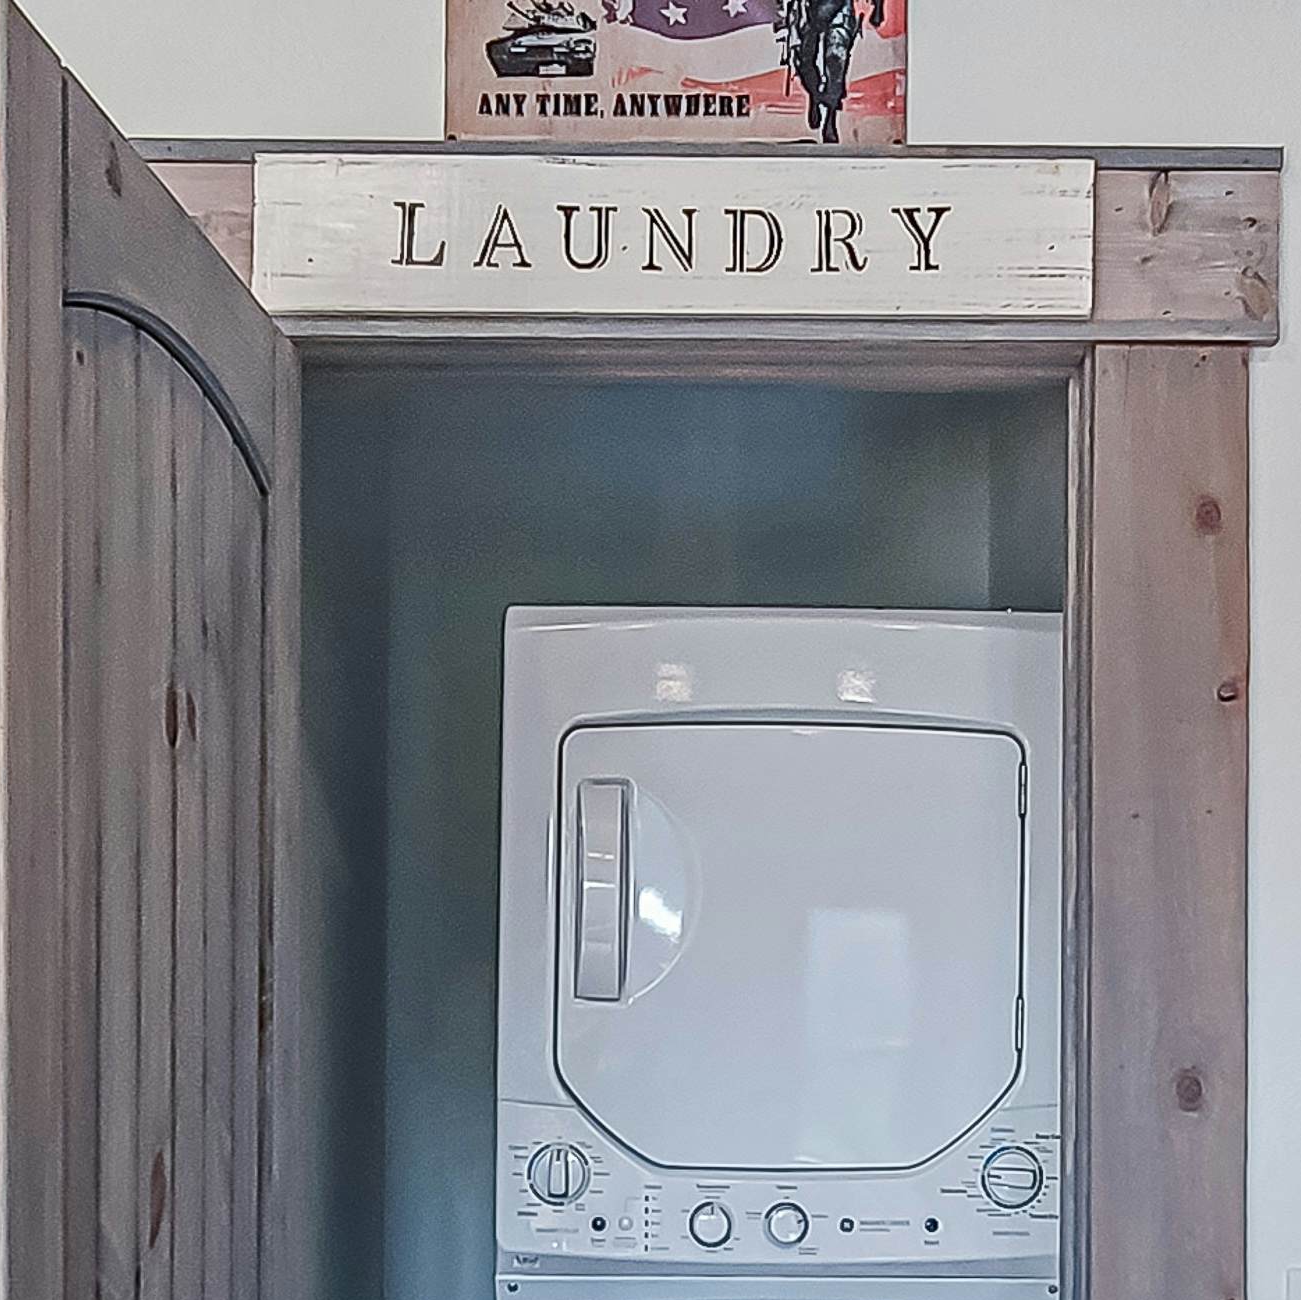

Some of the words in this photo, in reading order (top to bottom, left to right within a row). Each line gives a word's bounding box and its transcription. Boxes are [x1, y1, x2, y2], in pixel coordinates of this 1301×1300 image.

[477, 92, 528, 117] ANY
[535, 92, 605, 119] TIME,
[612, 92, 751, 118] ANYWHERE
[390, 201, 953, 273] LAUNDRY
